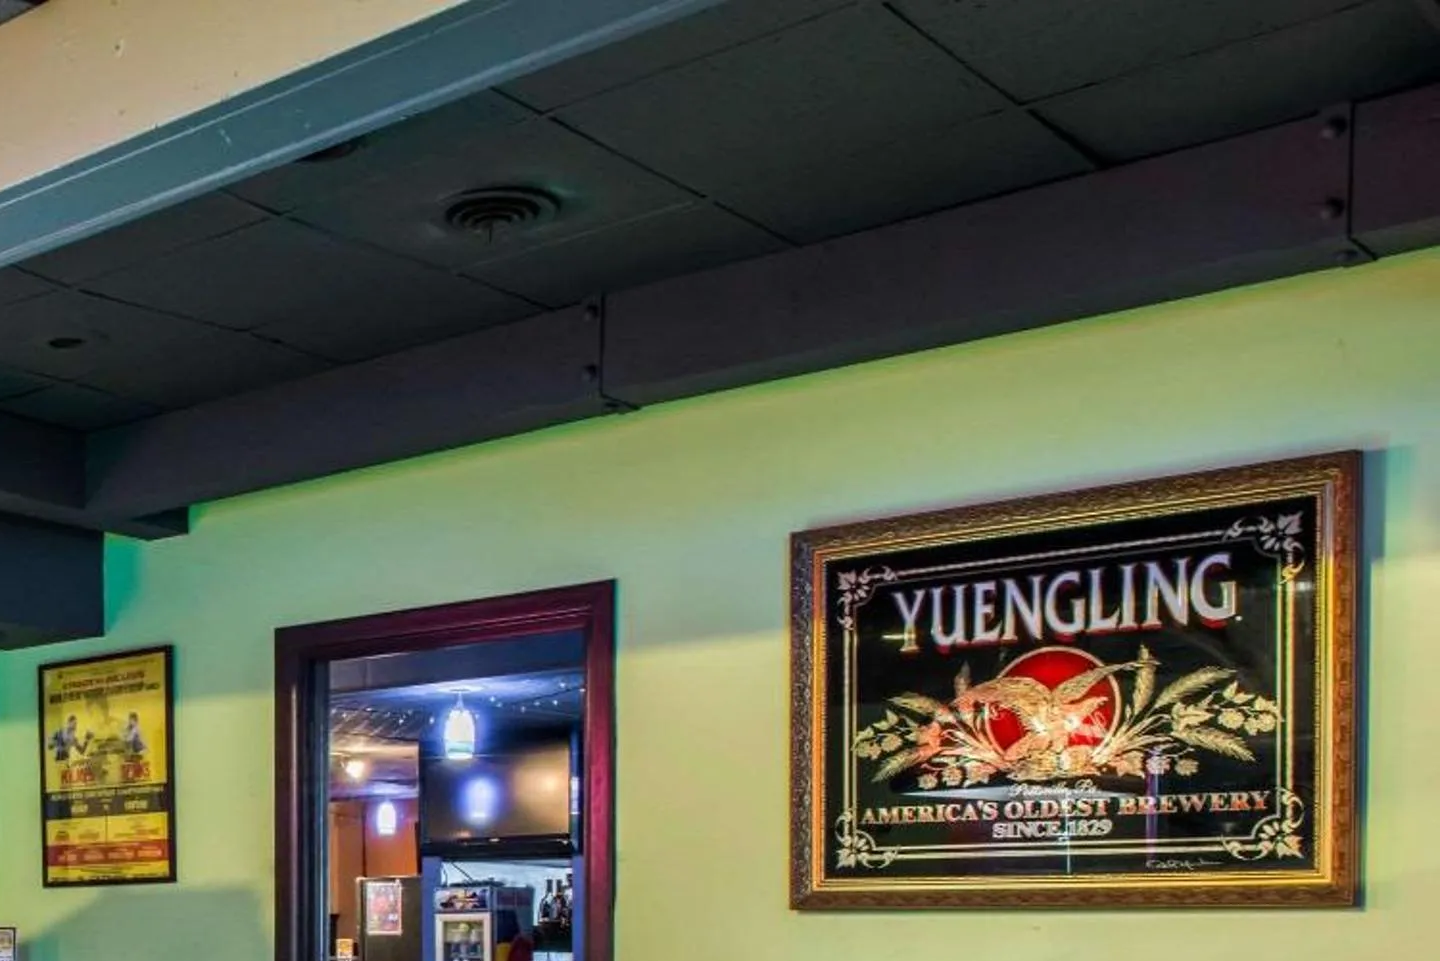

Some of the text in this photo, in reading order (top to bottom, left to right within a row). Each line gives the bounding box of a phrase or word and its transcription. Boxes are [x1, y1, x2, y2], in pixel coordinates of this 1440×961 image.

[893, 552, 1237, 652] YUENGLING
[861, 789, 1269, 825] AMERICA'S OLDEST BREWERY
[992, 819, 1113, 839] SINCE 1829
